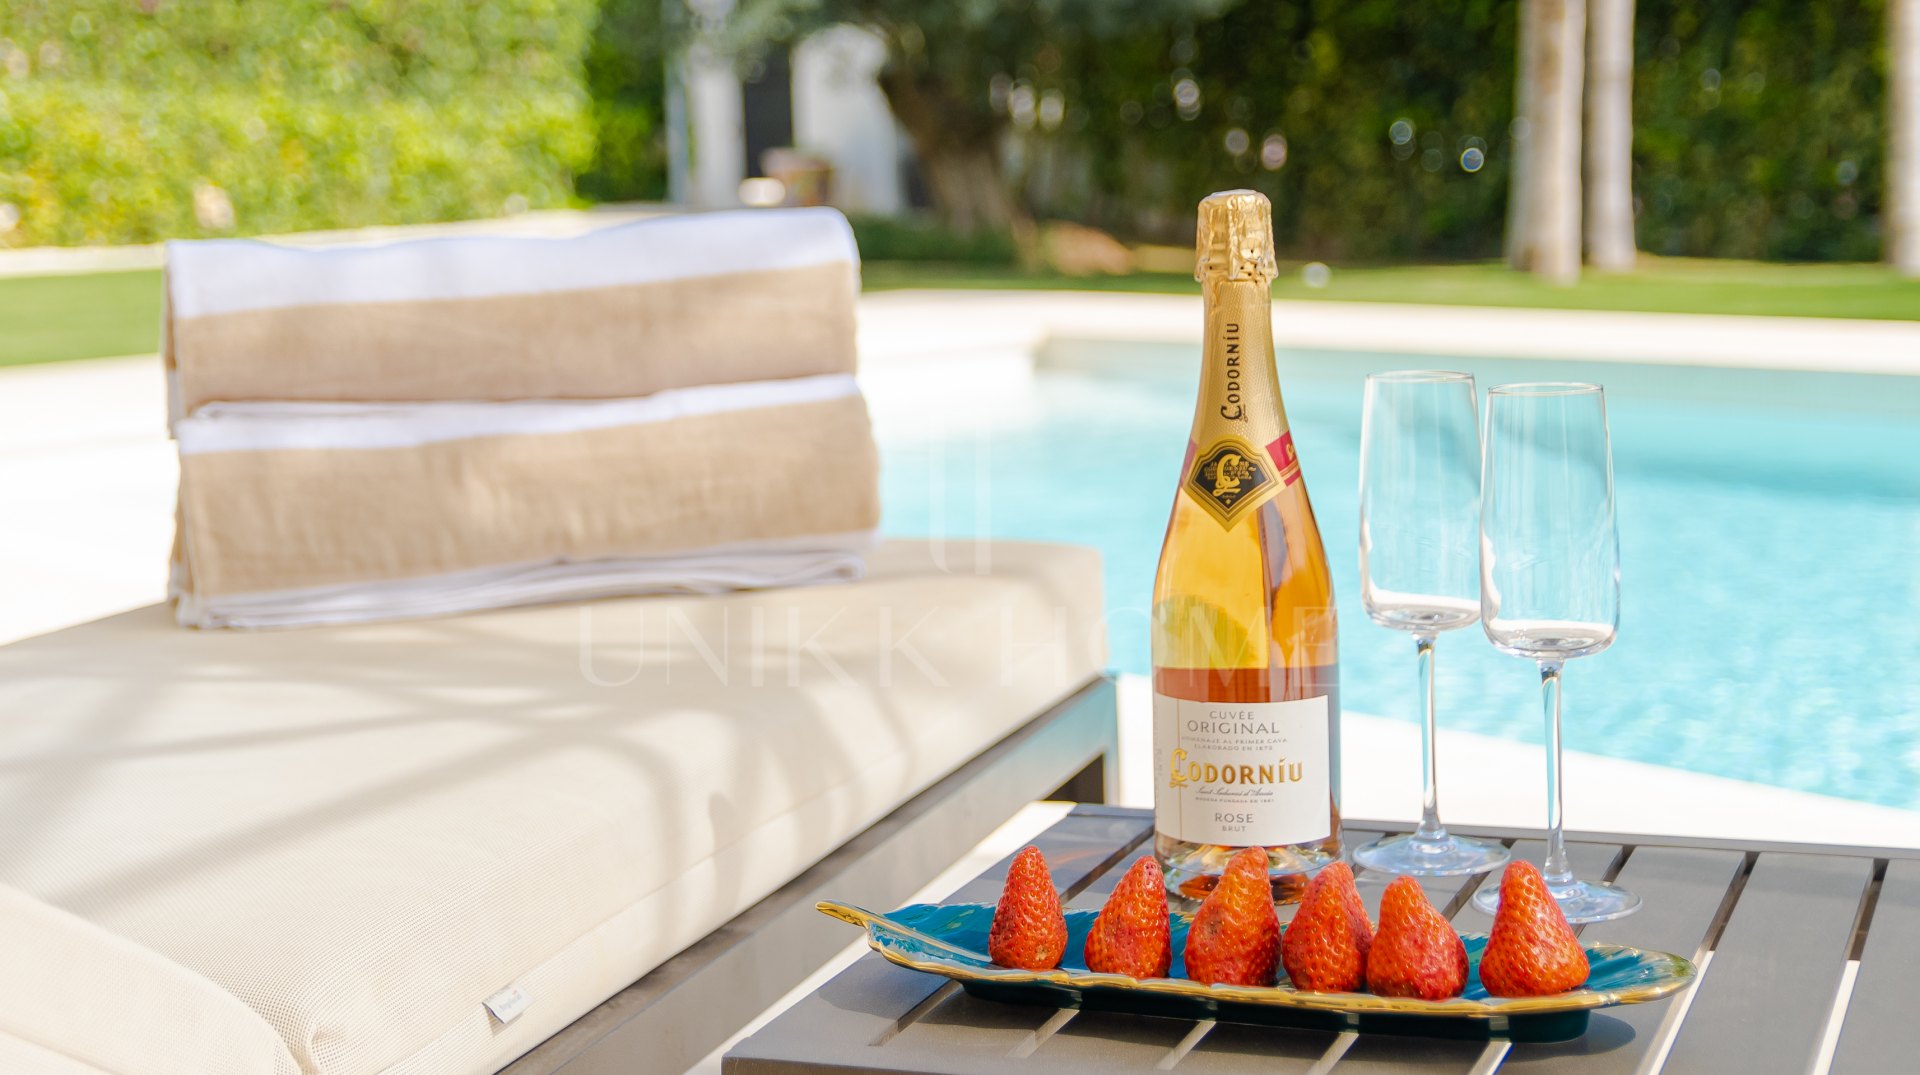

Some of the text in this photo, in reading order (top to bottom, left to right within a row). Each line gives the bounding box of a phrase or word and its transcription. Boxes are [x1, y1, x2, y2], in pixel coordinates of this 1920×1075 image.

[1220, 323, 1249, 424] CODORNÍU
[1209, 710, 1255, 720] CUVÉE
[1187, 719, 1280, 735] ORIGINAL
[1168, 747, 1303, 789] CODORNÍU
[1214, 812, 1254, 824] ROSE
